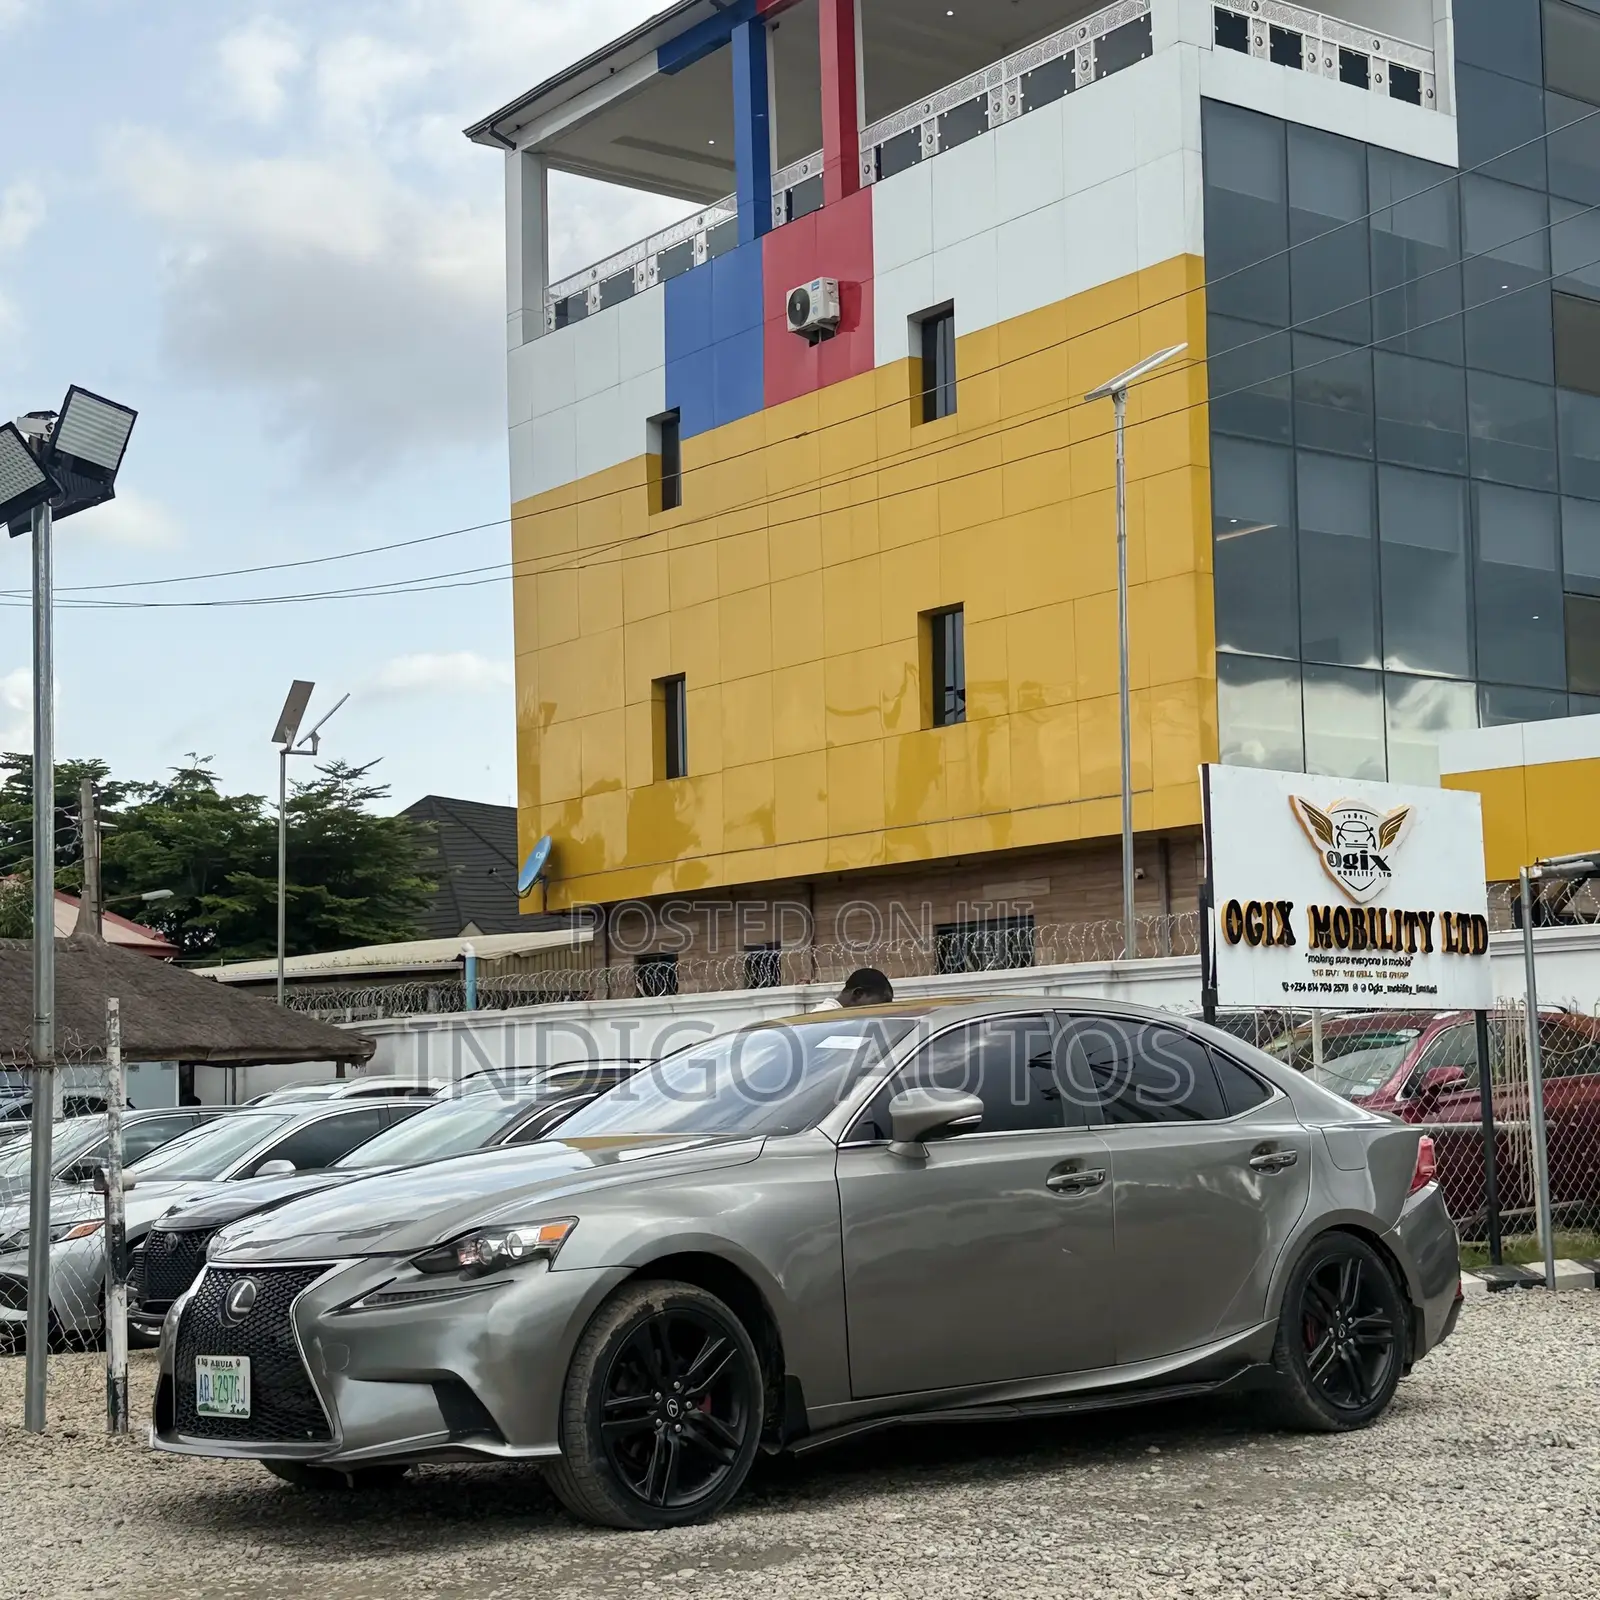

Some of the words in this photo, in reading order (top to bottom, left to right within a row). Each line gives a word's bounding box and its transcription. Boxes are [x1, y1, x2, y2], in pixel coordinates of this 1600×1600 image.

[1327, 849, 1391, 871] Ogix
[1221, 899, 1296, 947] OGIX
[1307, 904, 1435, 953] MOBILITY
[1440, 911, 1489, 955] LTD
[1382, 956, 1388, 966] is
